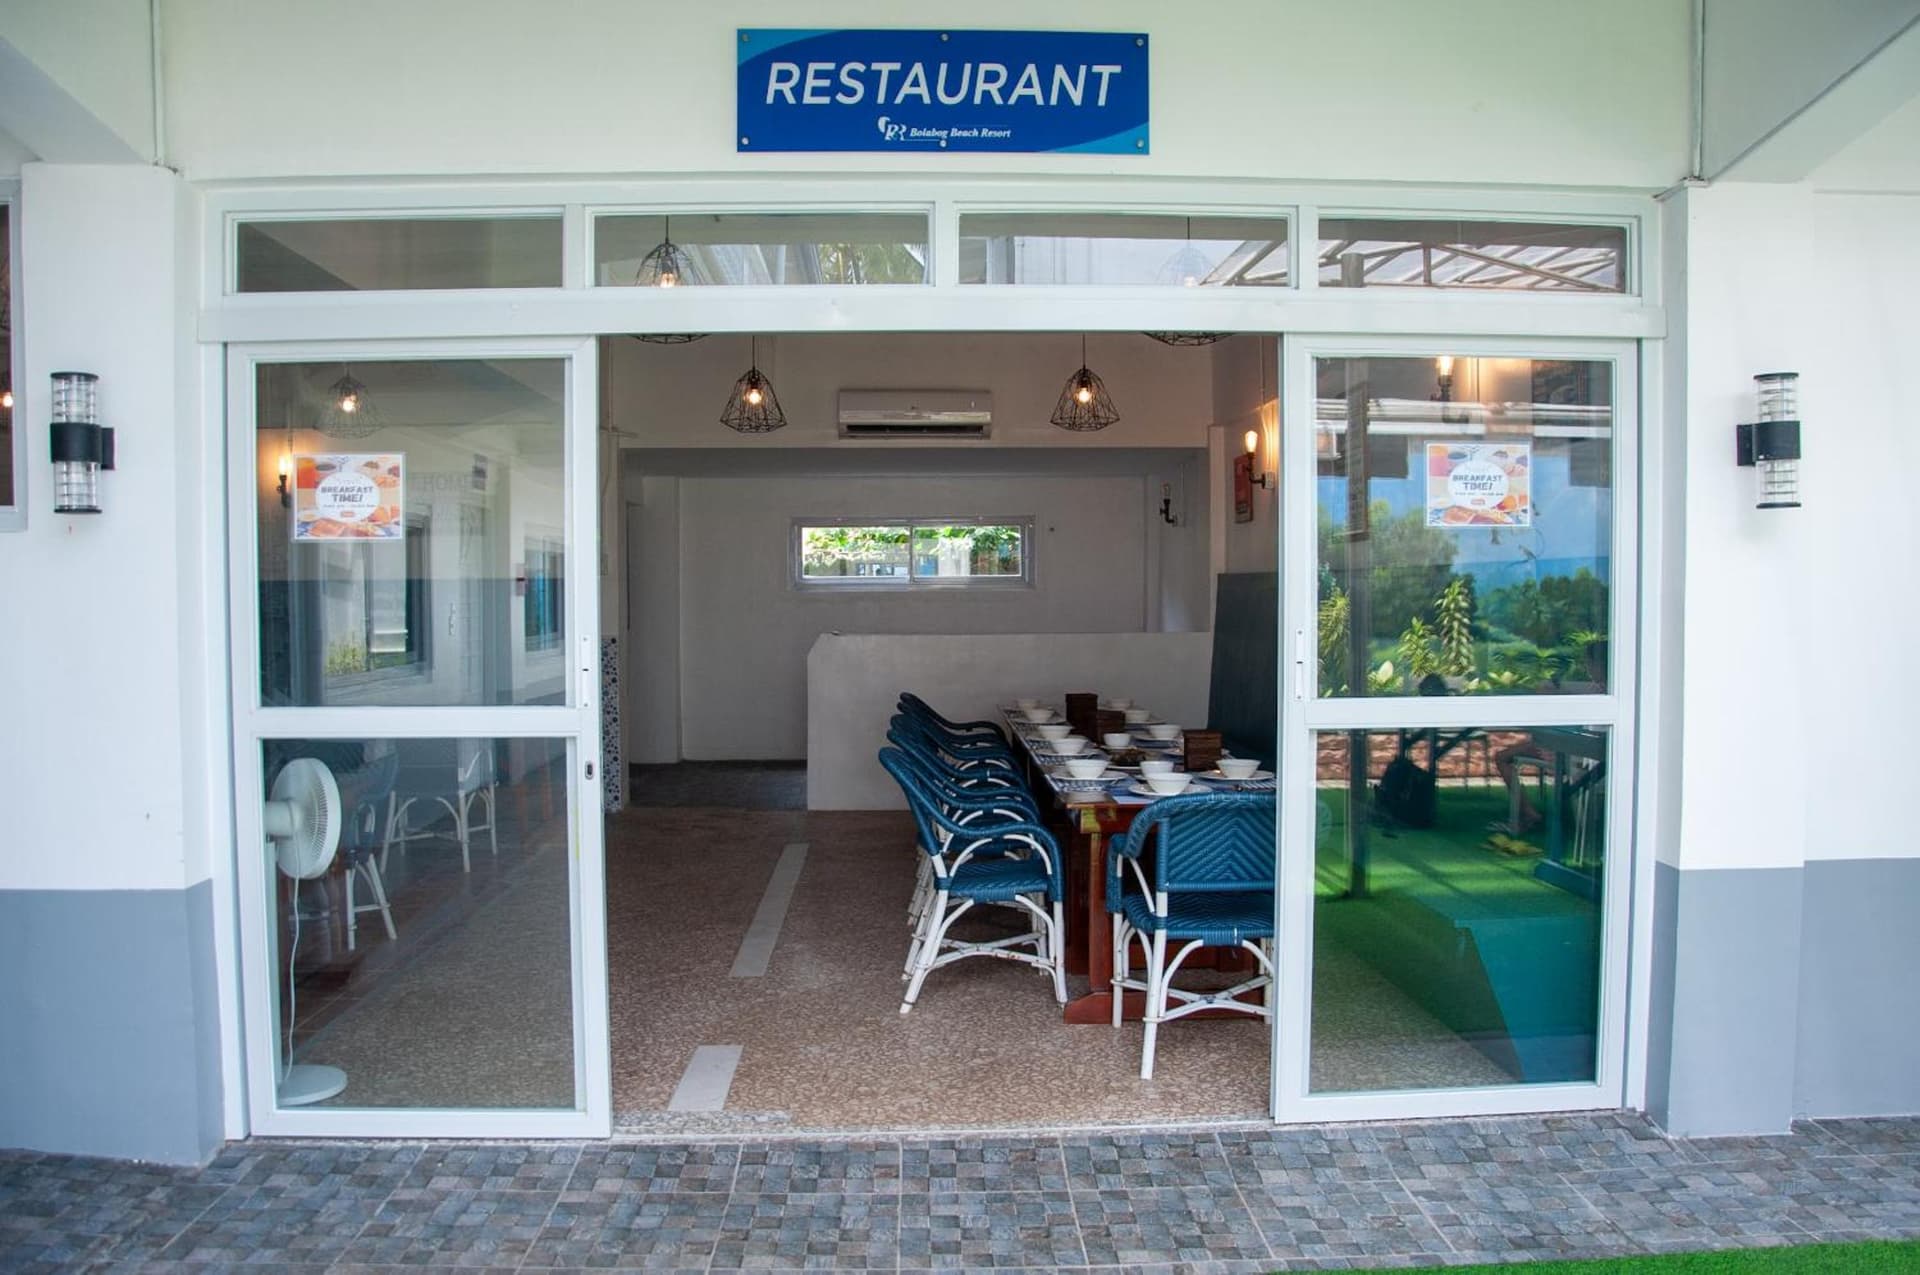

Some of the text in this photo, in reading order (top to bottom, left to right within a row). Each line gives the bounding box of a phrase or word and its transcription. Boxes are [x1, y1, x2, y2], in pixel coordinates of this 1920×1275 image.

[765, 61, 1122, 106] RESTAURANT
[950, 127, 979, 138] Beach
[980, 127, 1012, 138] Resort
[1452, 474, 1503, 482] BREAKFAST
[320, 486, 374, 494] BREAKFAST
[1463, 482, 1494, 491] TIME!
[331, 494, 364, 503] TIME!
